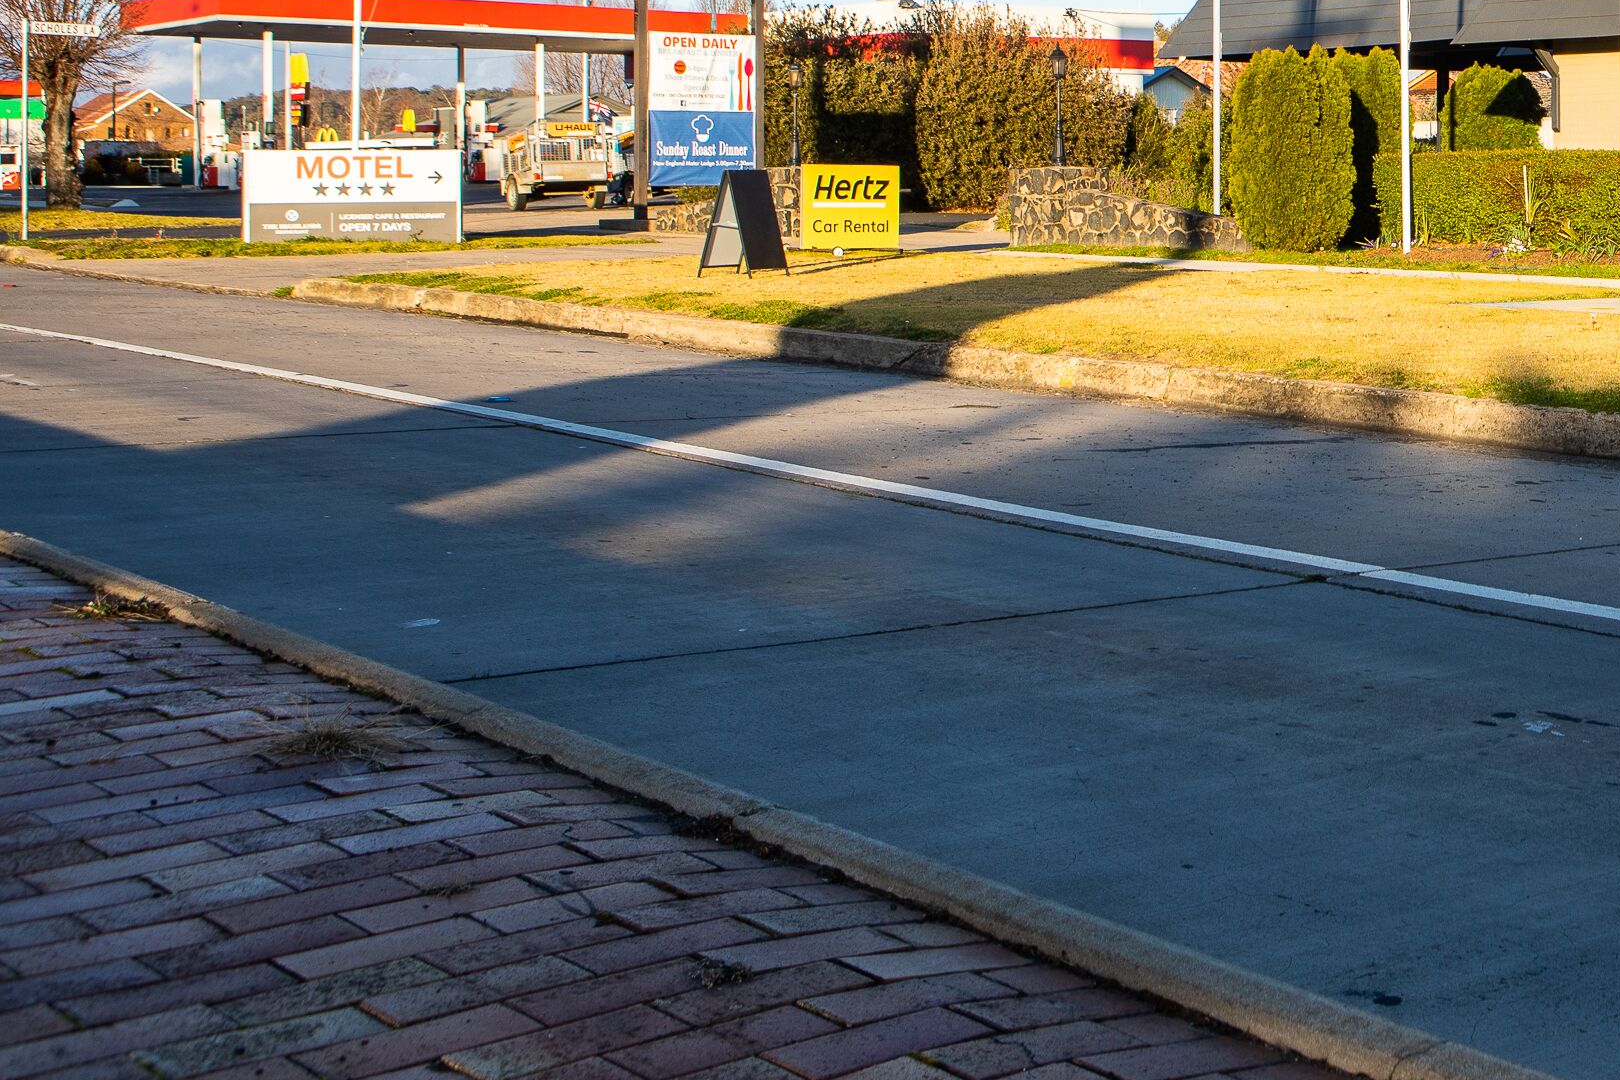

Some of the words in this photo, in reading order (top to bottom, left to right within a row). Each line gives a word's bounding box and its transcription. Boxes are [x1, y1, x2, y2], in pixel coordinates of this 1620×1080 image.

[34, 23, 79, 35] SCHOLES
[83, 26, 96, 36] LA
[663, 36, 697, 48] OPEN
[702, 38, 738, 50] DAILY
[656, 141, 690, 160] Sunday
[691, 141, 717, 157] Roast
[718, 141, 749, 156] Dinner
[296, 156, 414, 179] MOTEL
[814, 174, 890, 200] Hertz
[401, 212, 446, 220] RESTAURANT
[339, 222, 371, 233] OPEN
[373, 222, 380, 232] 7
[381, 221, 412, 232] DAYS
[812, 219, 839, 233] Car
[844, 219, 889, 233] Rental
